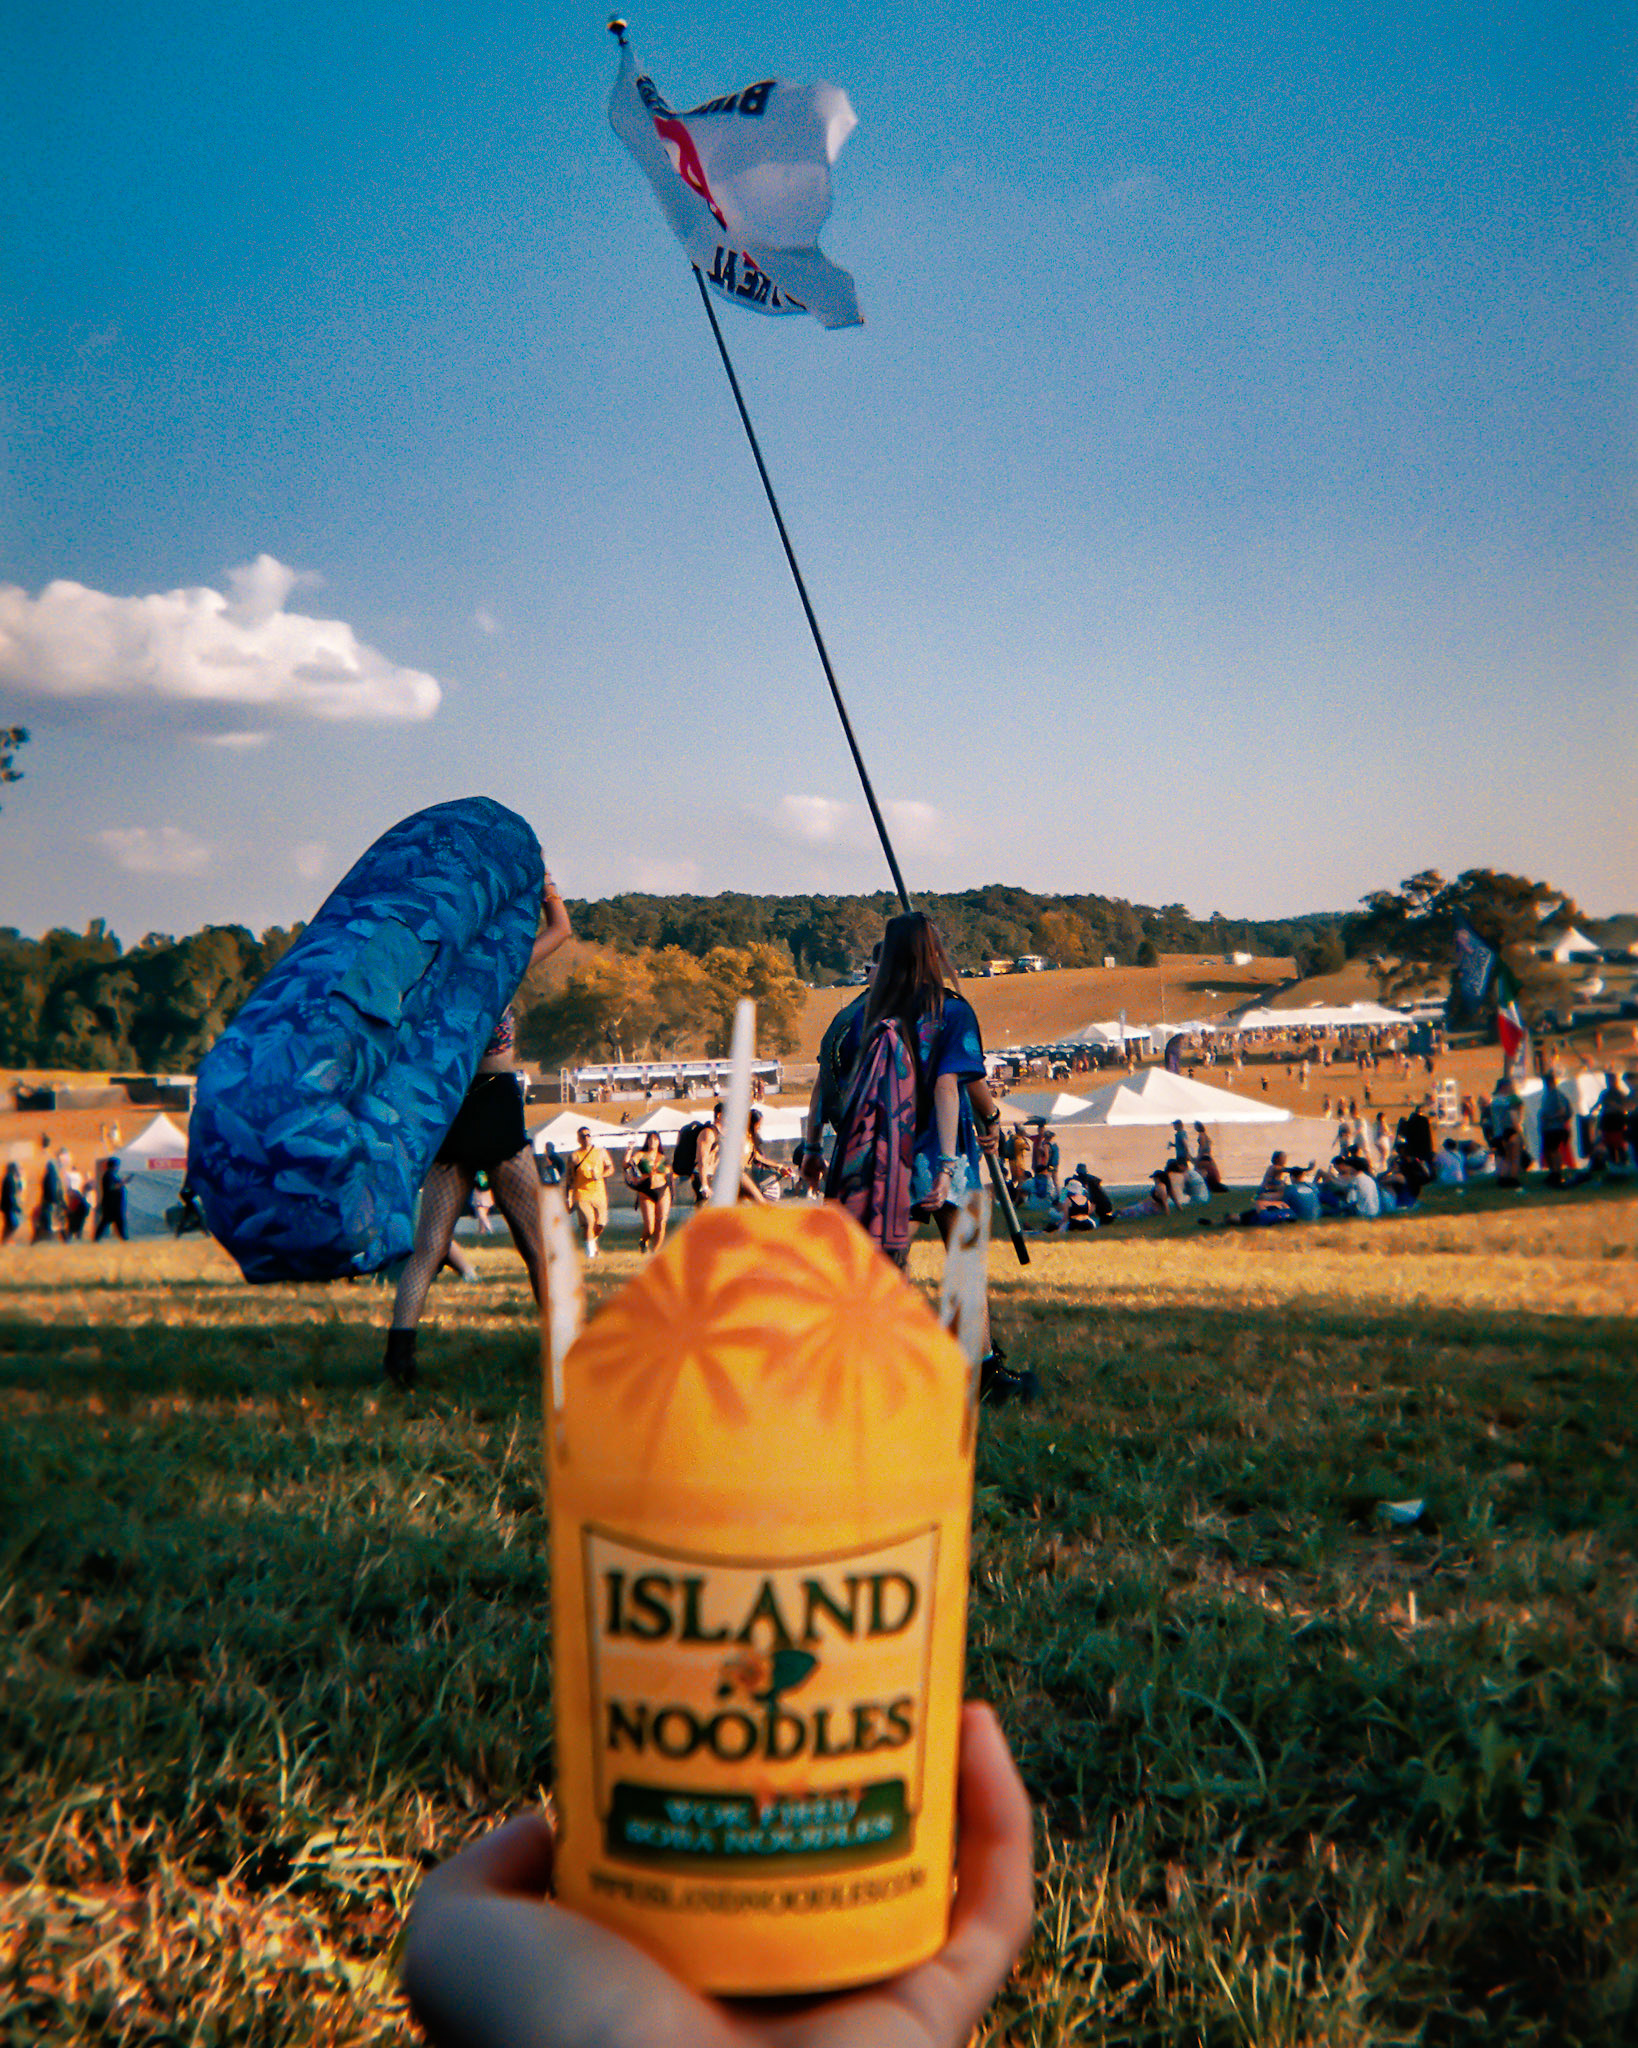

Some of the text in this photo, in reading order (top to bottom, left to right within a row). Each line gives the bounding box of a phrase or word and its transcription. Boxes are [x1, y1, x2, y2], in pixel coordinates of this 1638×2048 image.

[605, 1570, 917, 1647] ISLAND
[606, 1697, 914, 1762] NOODLES
[665, 1799, 751, 1830] WOK
[724, 1814, 894, 1853] NOODLES
